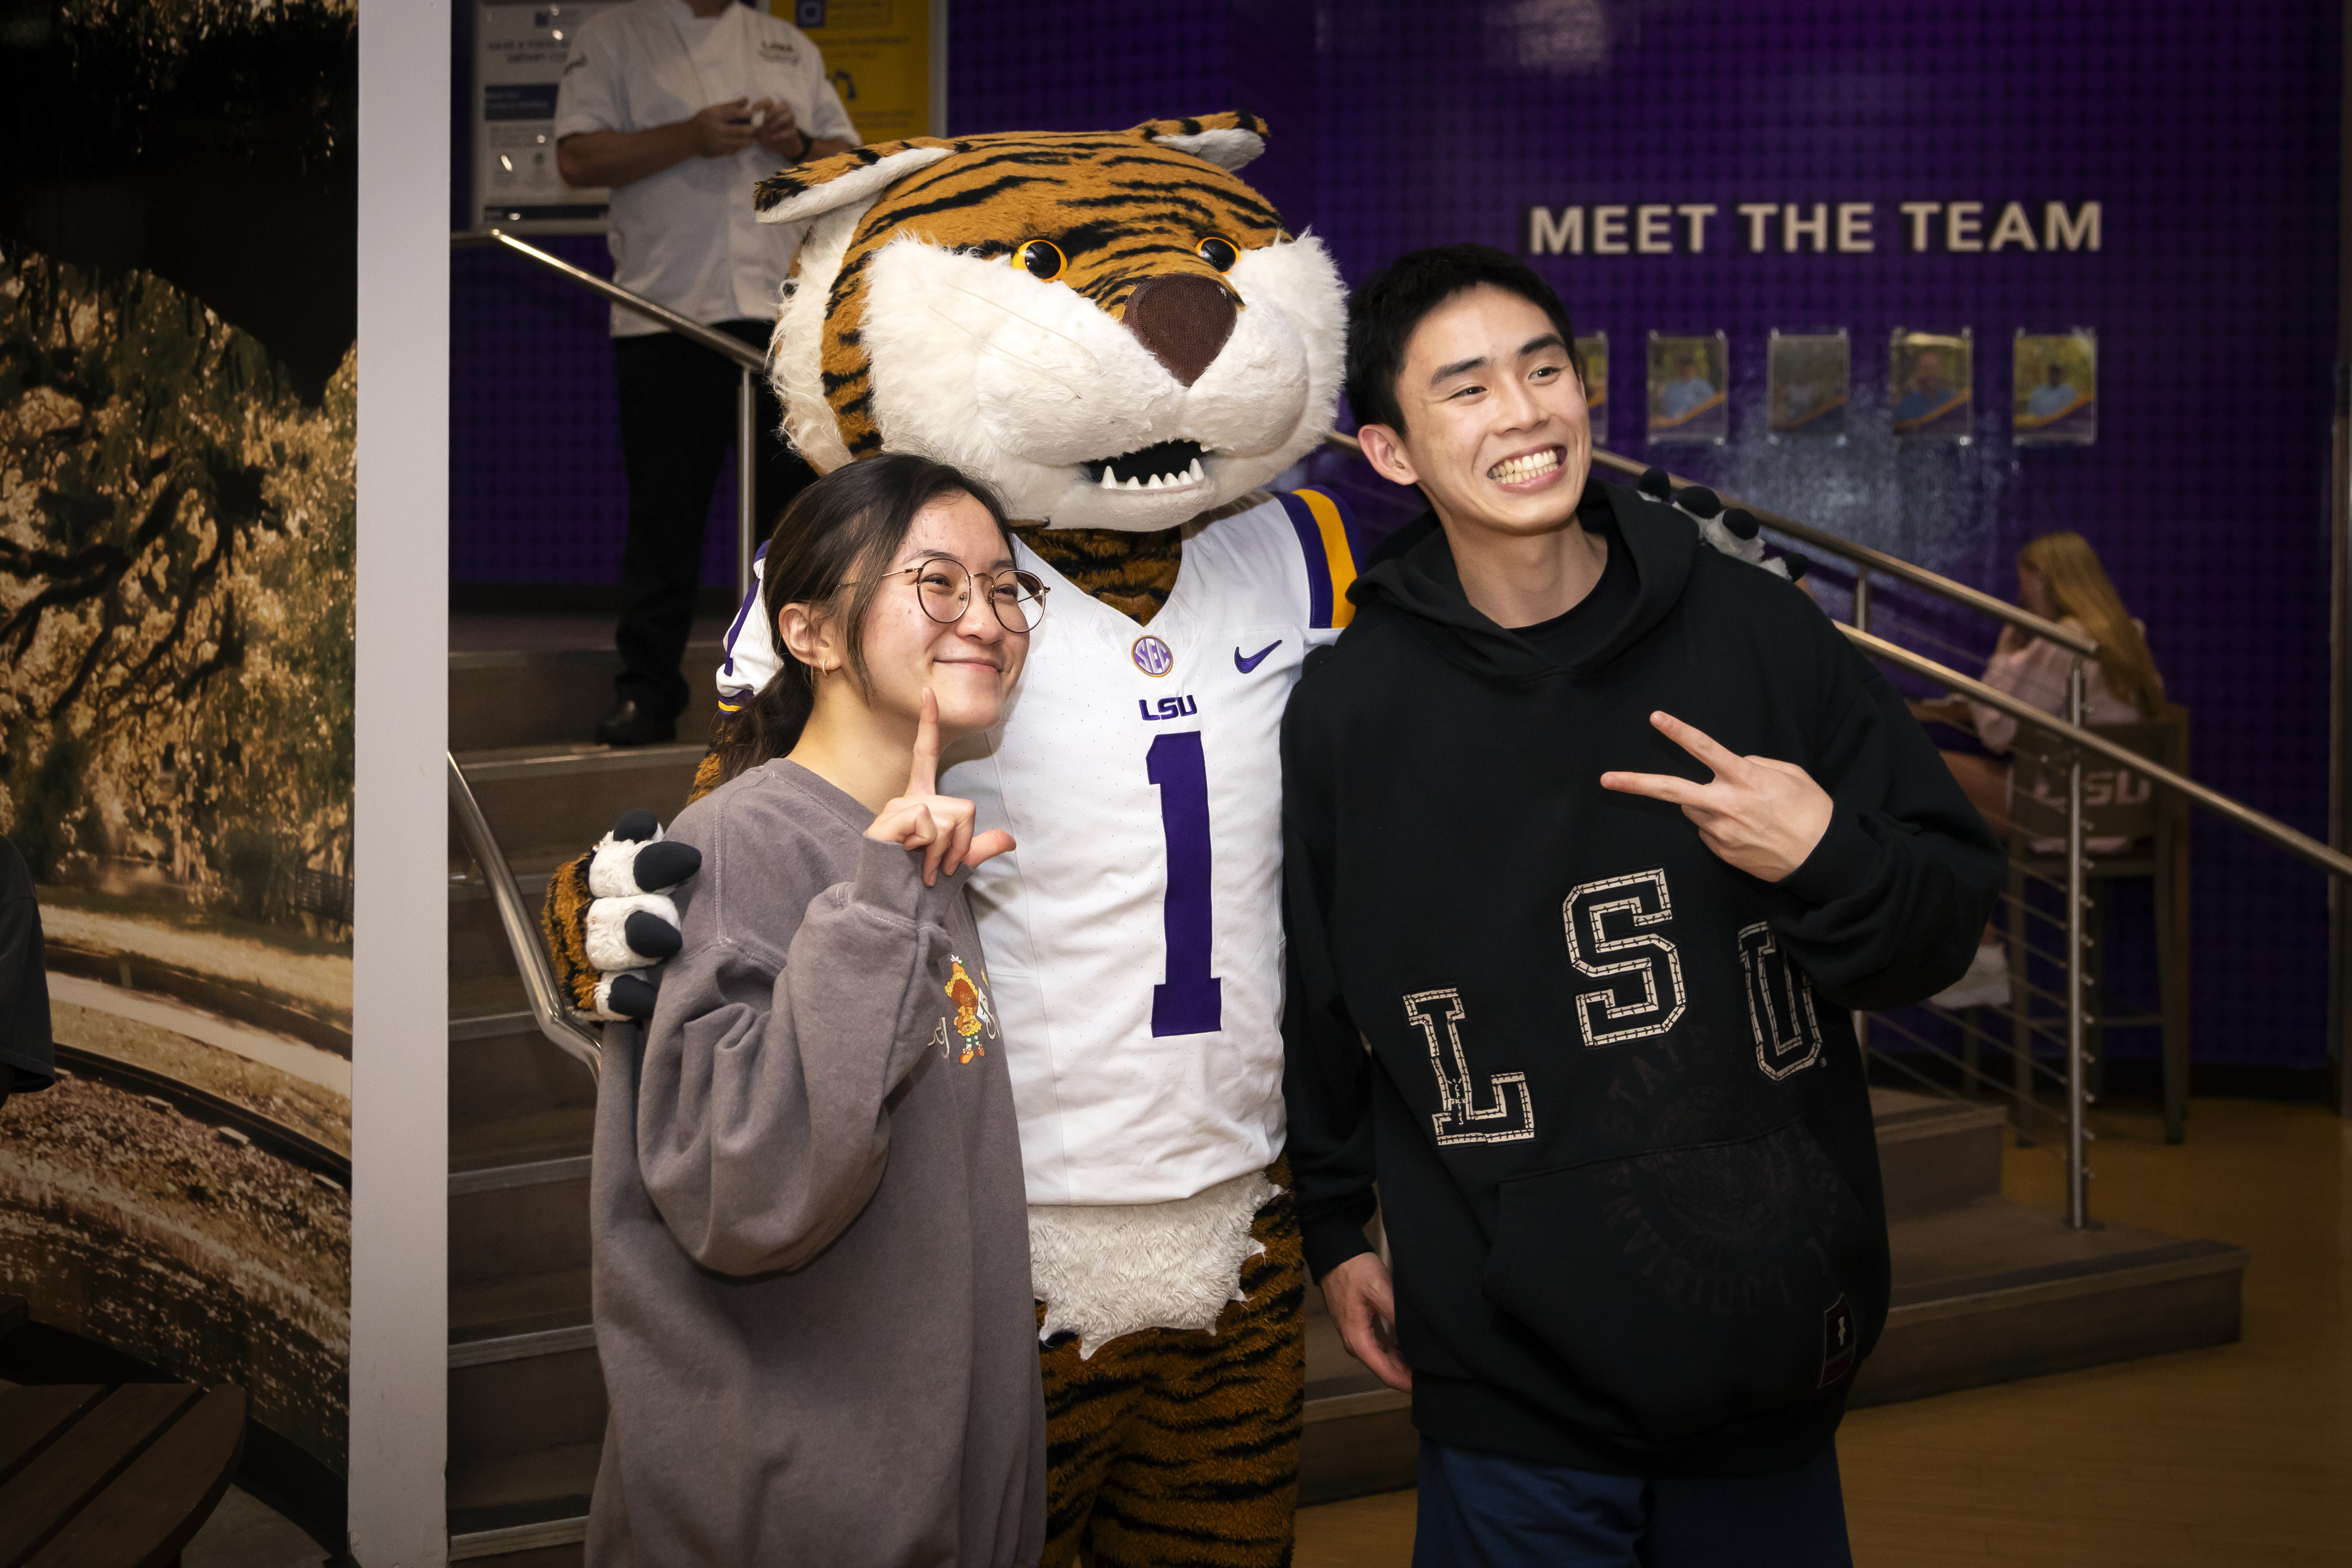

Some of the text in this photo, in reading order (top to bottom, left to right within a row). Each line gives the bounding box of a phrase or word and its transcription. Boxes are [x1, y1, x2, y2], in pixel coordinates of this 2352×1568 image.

[1530, 200, 2103, 255] MEET THE TEAM
[1133, 637, 1171, 676] SEC
[1138, 694, 1198, 721] LSU
[1146, 730, 1221, 1038] 1
